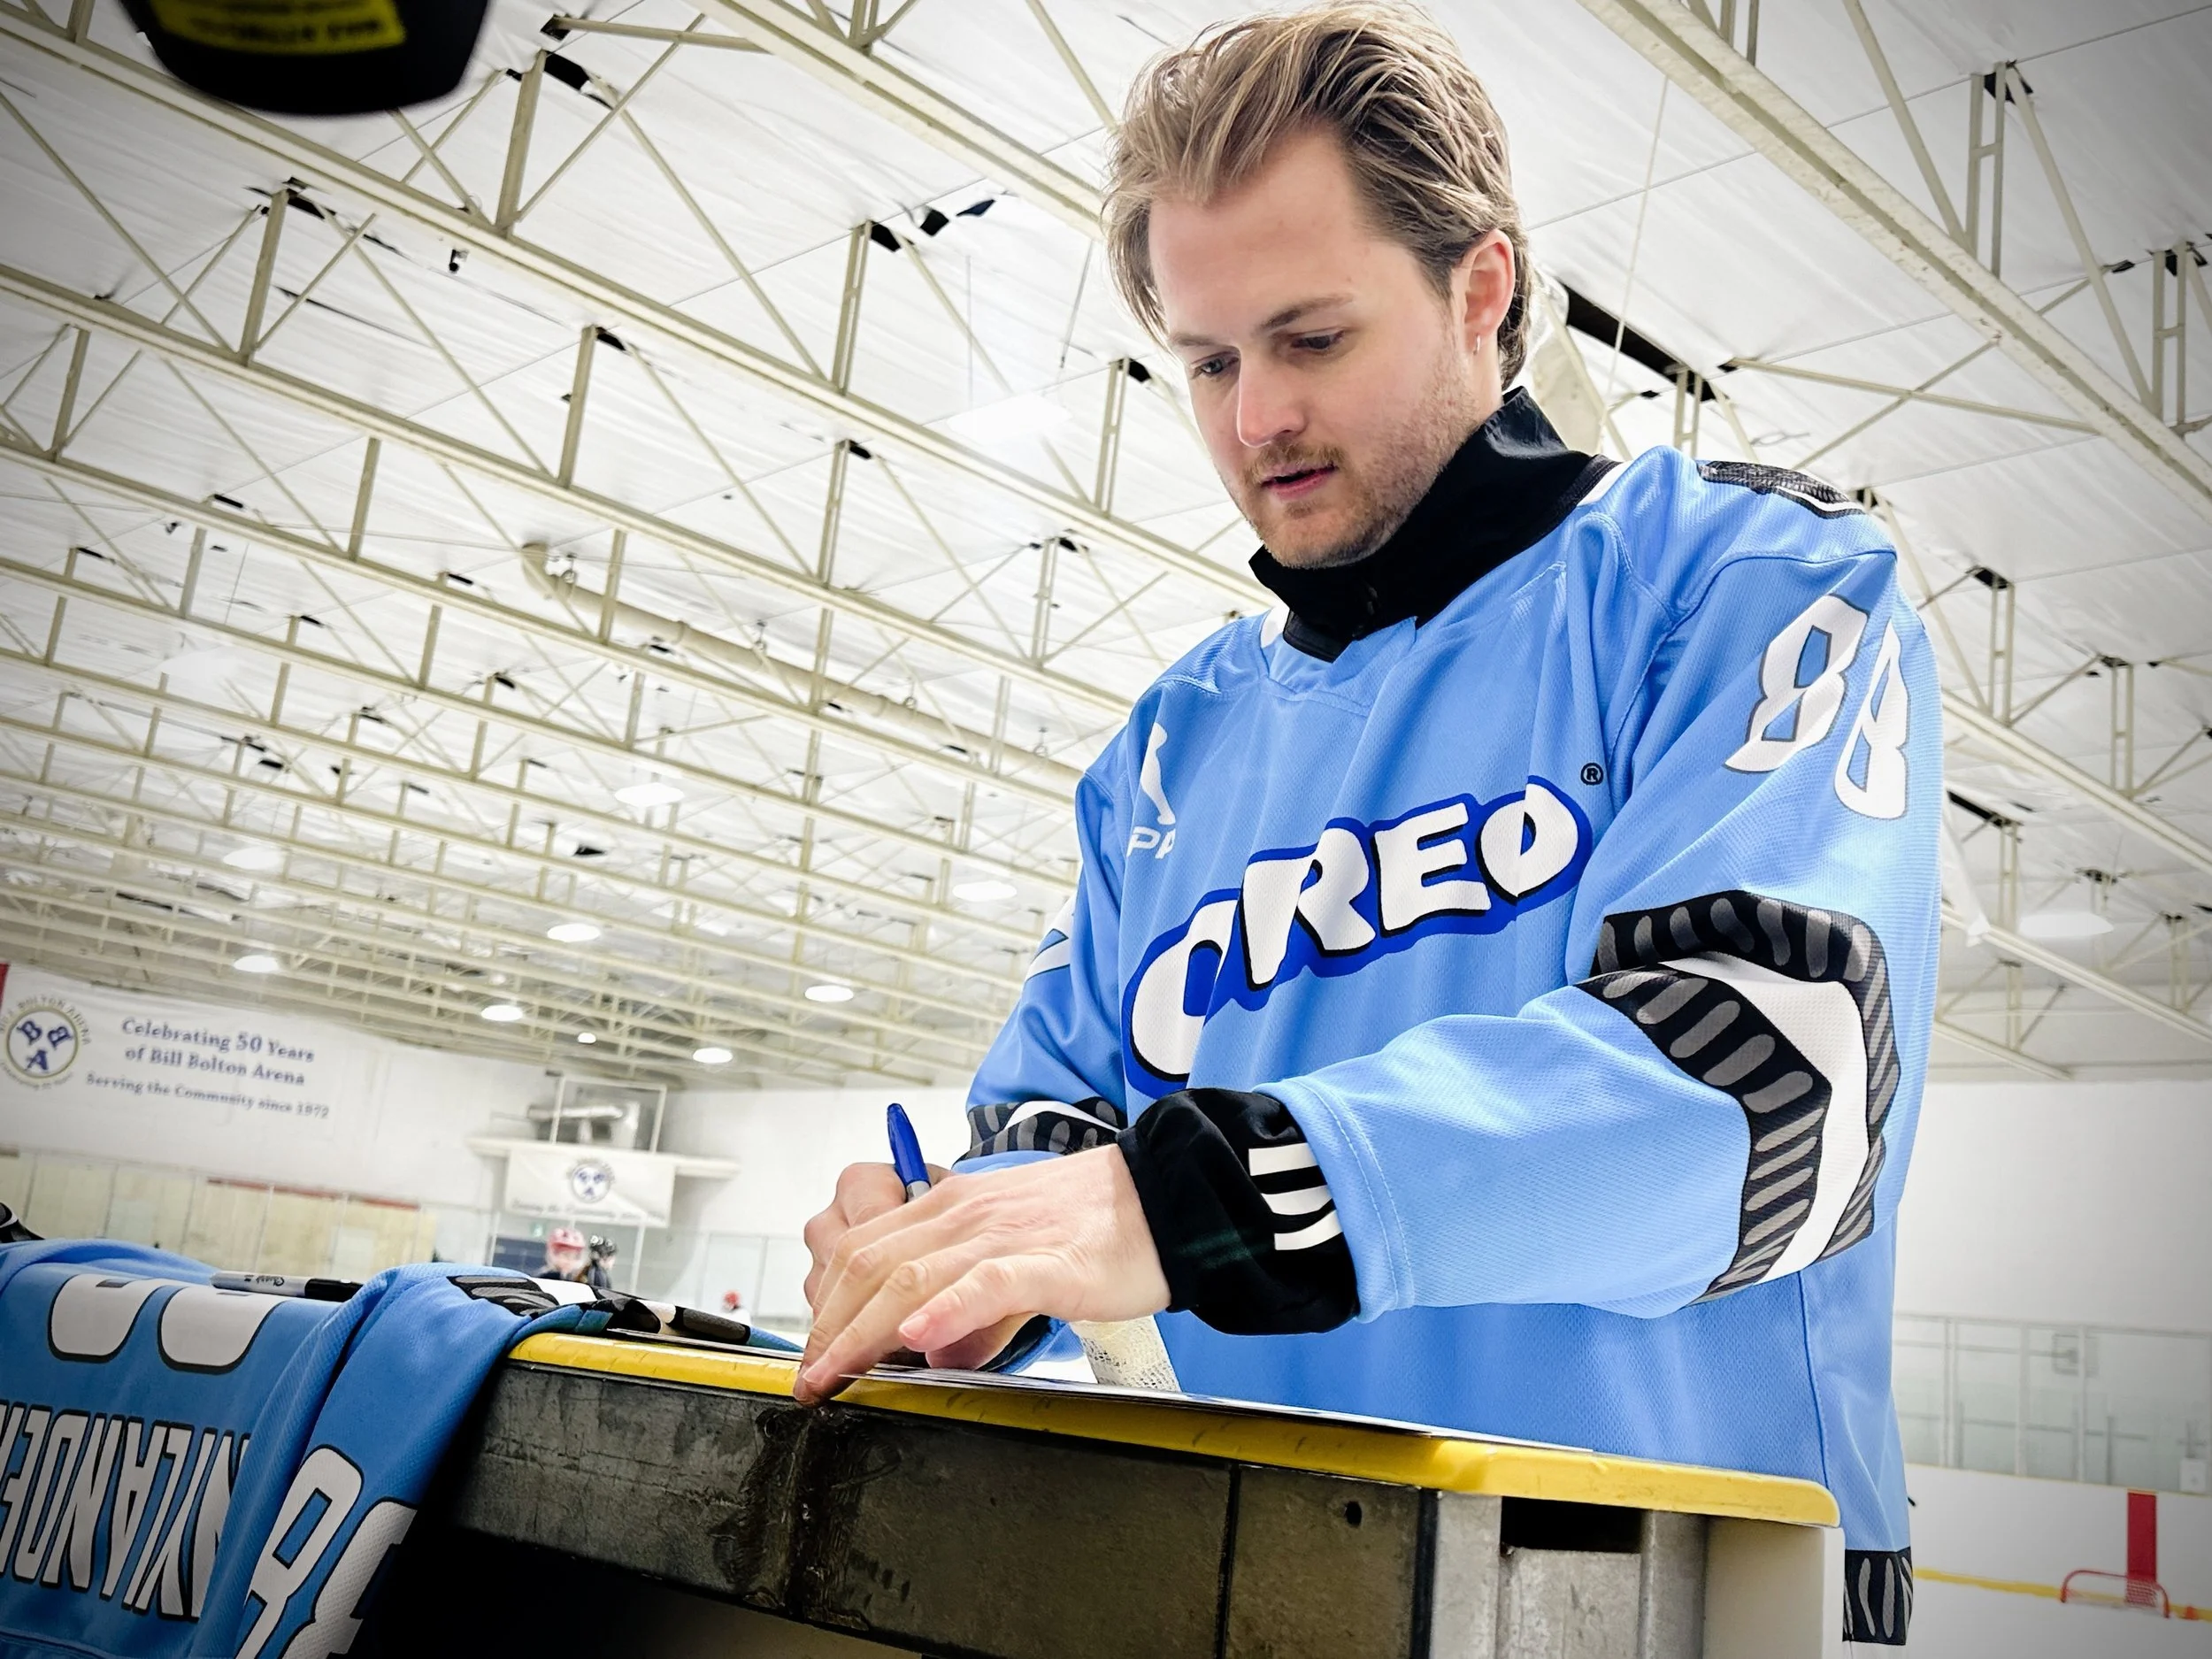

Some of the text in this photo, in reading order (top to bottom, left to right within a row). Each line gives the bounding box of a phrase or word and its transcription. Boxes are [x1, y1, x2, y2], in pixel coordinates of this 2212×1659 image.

[1724, 593, 1909, 819] 88
[1131, 782, 1580, 1082] OREO
[121, 1018, 315, 1063] Celebrating 50 Years
[125, 1046, 305, 1086] of Bill Bolton Arena
[86, 1073, 142, 1095] Serving
[148, 1079, 170, 1094] the
[175, 1085, 254, 1110] Community
[258, 1097, 293, 1113] since
